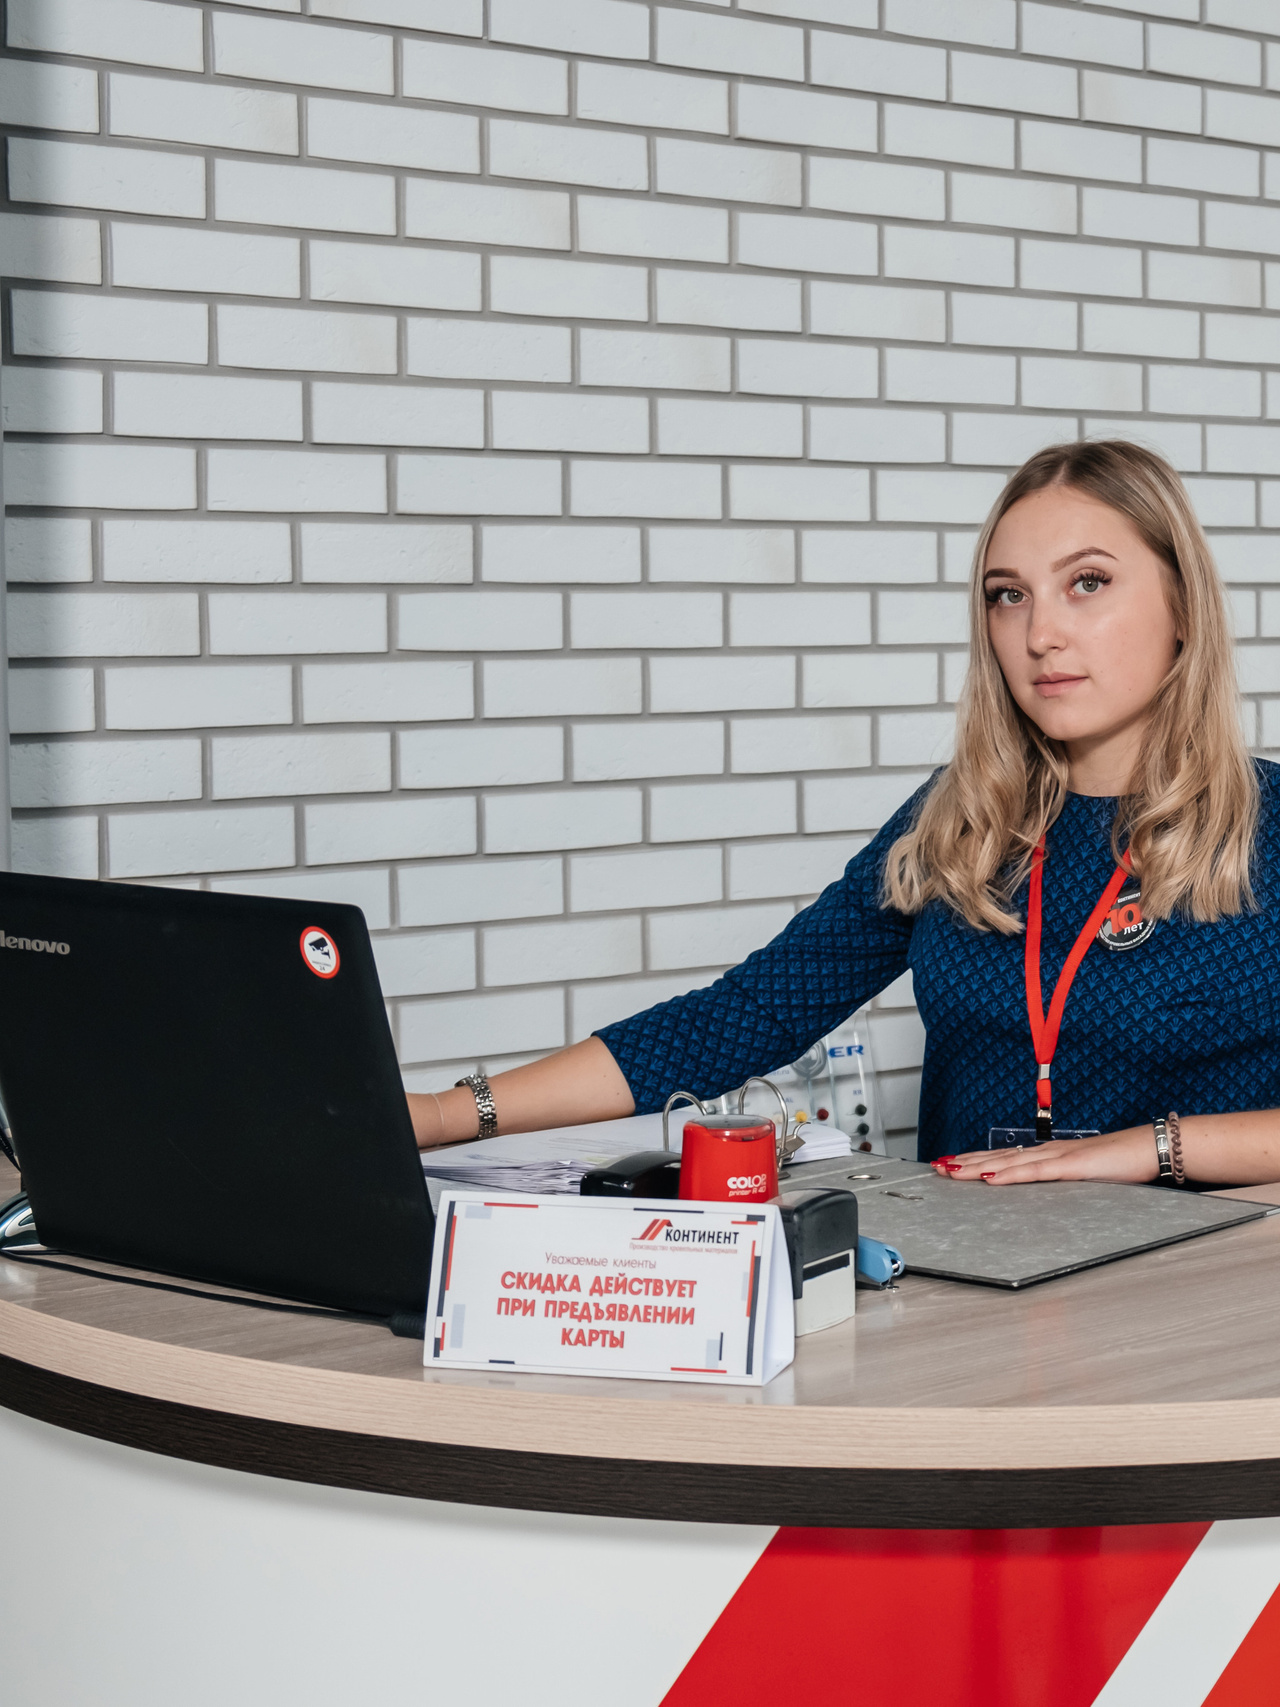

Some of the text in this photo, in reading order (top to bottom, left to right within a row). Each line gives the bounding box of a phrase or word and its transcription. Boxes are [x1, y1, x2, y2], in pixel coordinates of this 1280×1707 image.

[1106, 903, 1142, 934] 10
[1124, 922, 1144, 935] лет
[0, 930, 70, 955] lenovo
[727, 1173, 767, 1189] COLOP
[665, 1229, 740, 1244] КОНТИНЕНТ
[545, 1252, 657, 1269] Уважаемые клиенты
[500, 1271, 697, 1298] СКИДКА ДЕЙСТВУЕТ
[497, 1297, 695, 1325] ПРИ ПРЕДЪЯВЛЕНИИ
[561, 1328, 625, 1348] КАРТЫ
